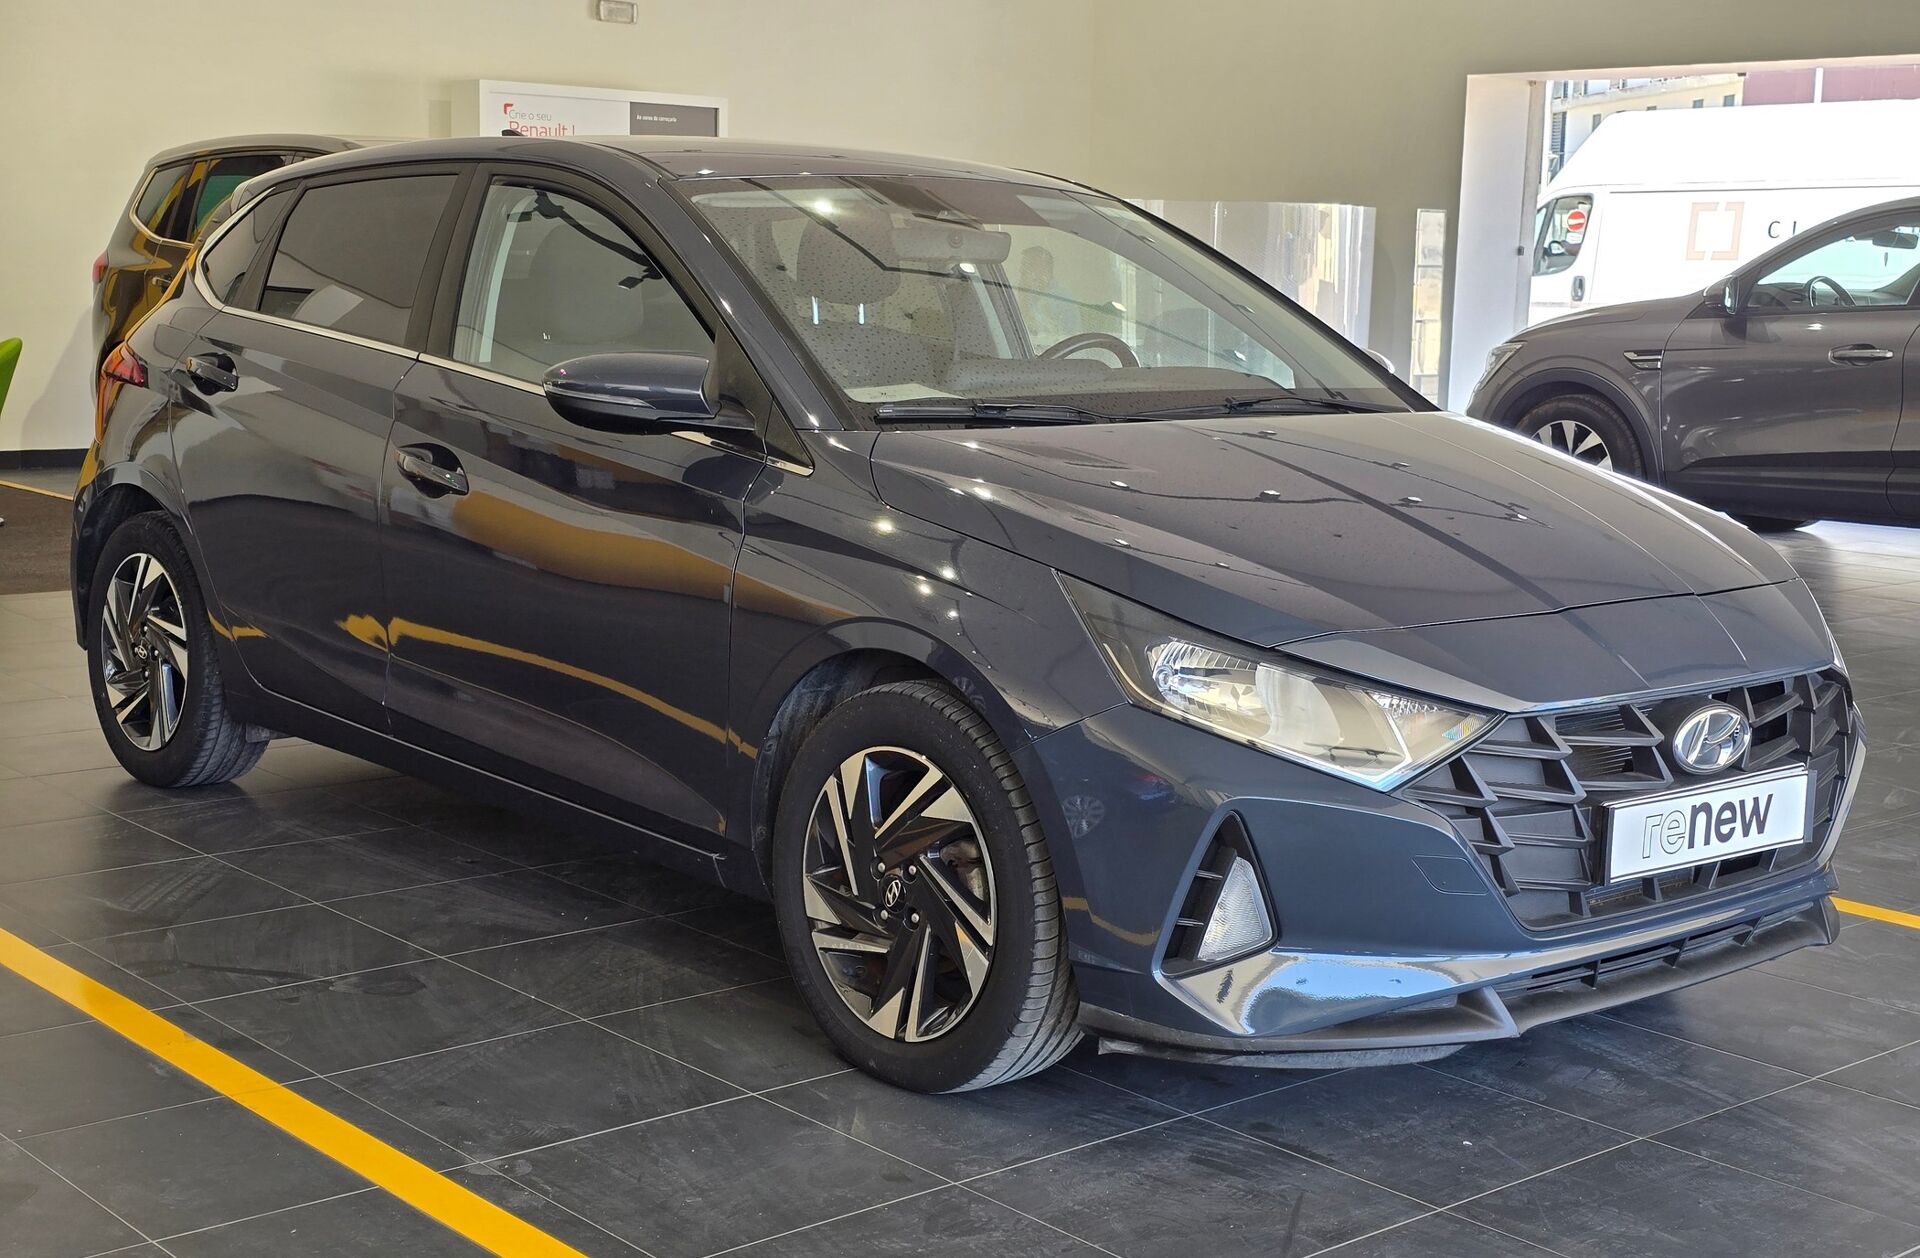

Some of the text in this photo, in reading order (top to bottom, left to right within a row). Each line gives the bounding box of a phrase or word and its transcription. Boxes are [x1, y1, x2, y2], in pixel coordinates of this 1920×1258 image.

[508, 109, 552, 121] Crie o seu
[509, 120, 568, 136] Renault
[1642, 793, 1773, 859] renew
